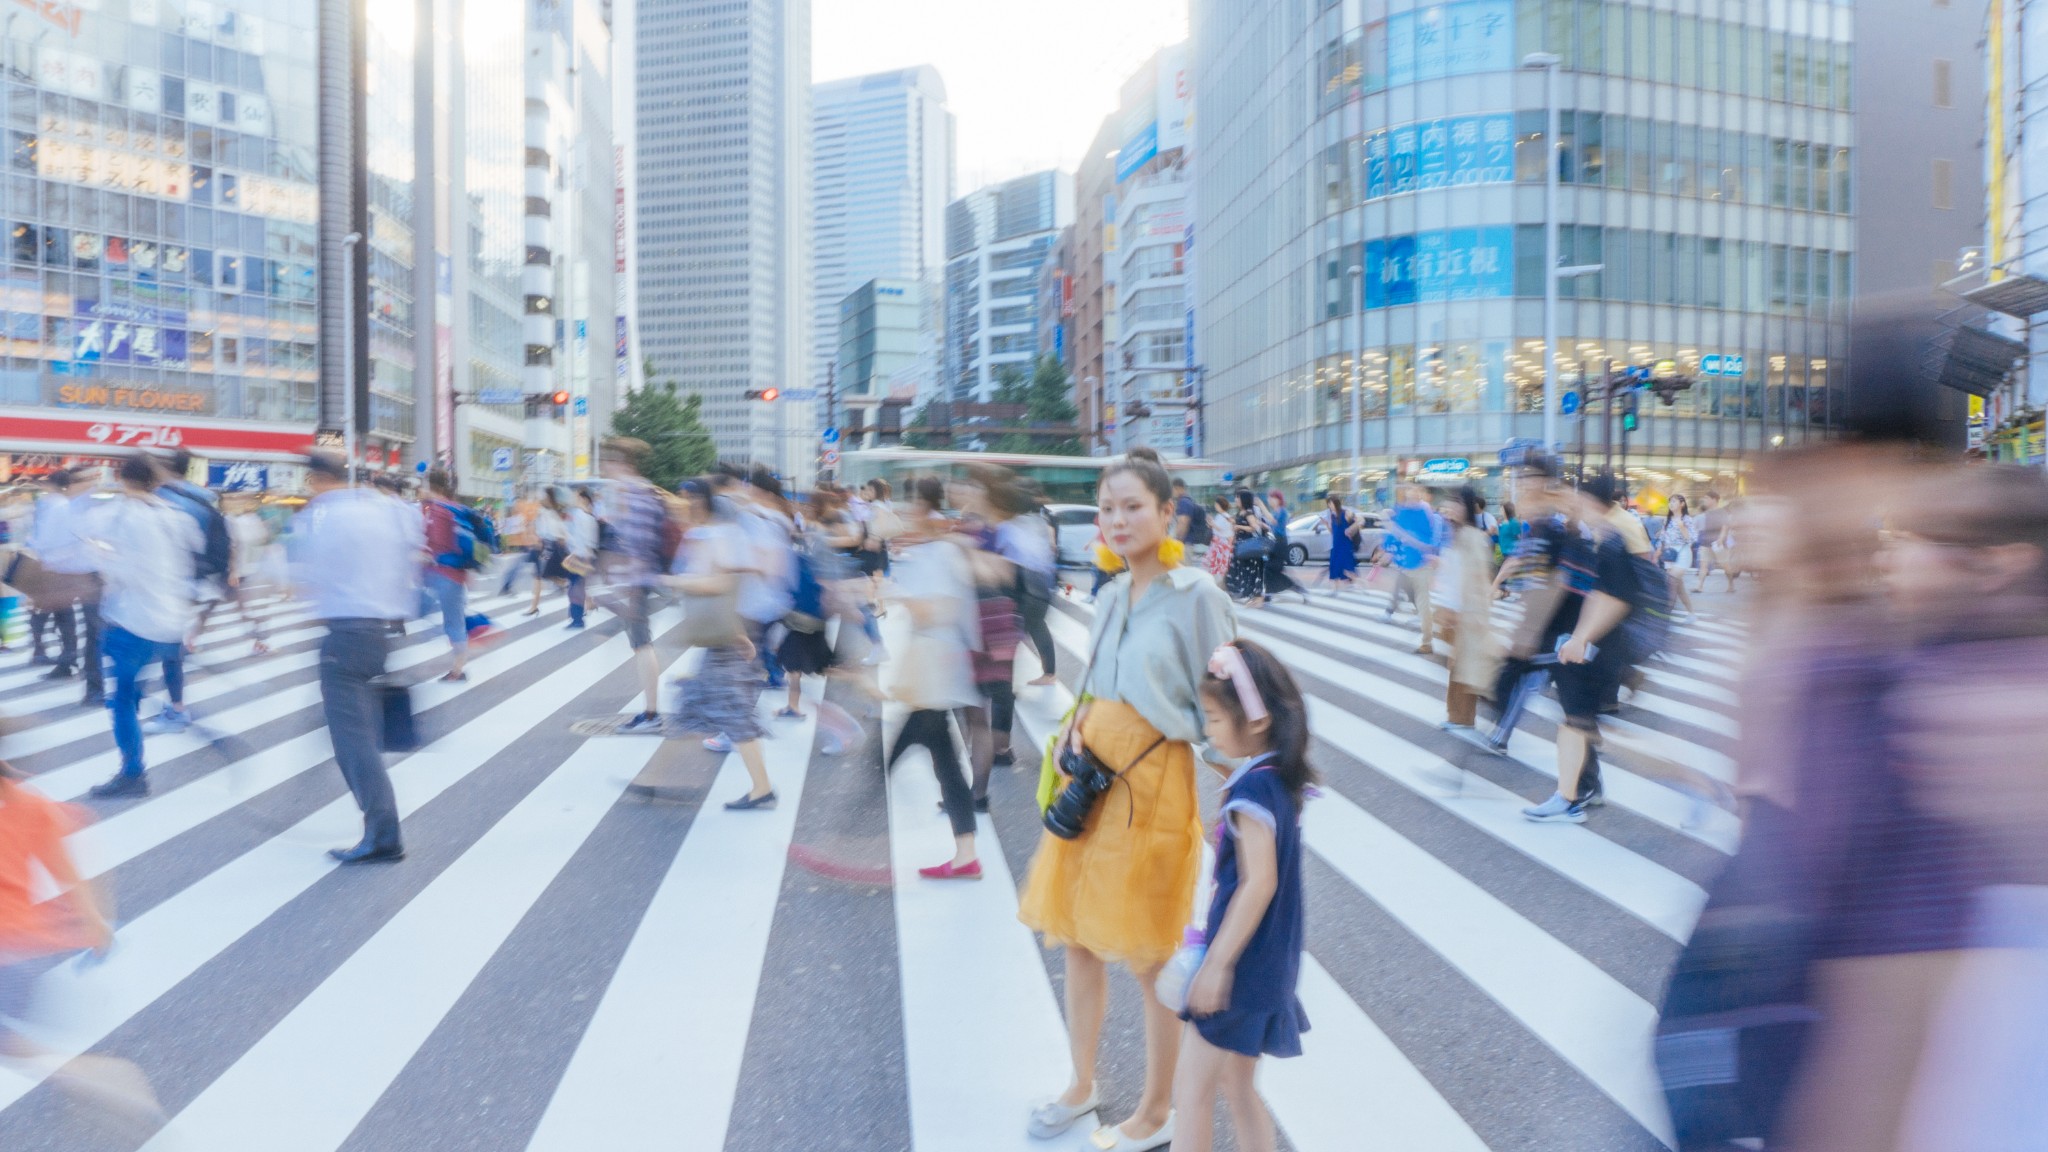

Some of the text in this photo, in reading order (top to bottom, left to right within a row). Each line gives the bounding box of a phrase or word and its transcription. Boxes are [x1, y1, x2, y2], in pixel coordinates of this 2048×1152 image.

[1371, 144, 1509, 181] クリニック
[75, 318, 163, 358] 大戸屋
[59, 383, 205, 411] SUN FLOWER
[114, 423, 183, 447] アコム
